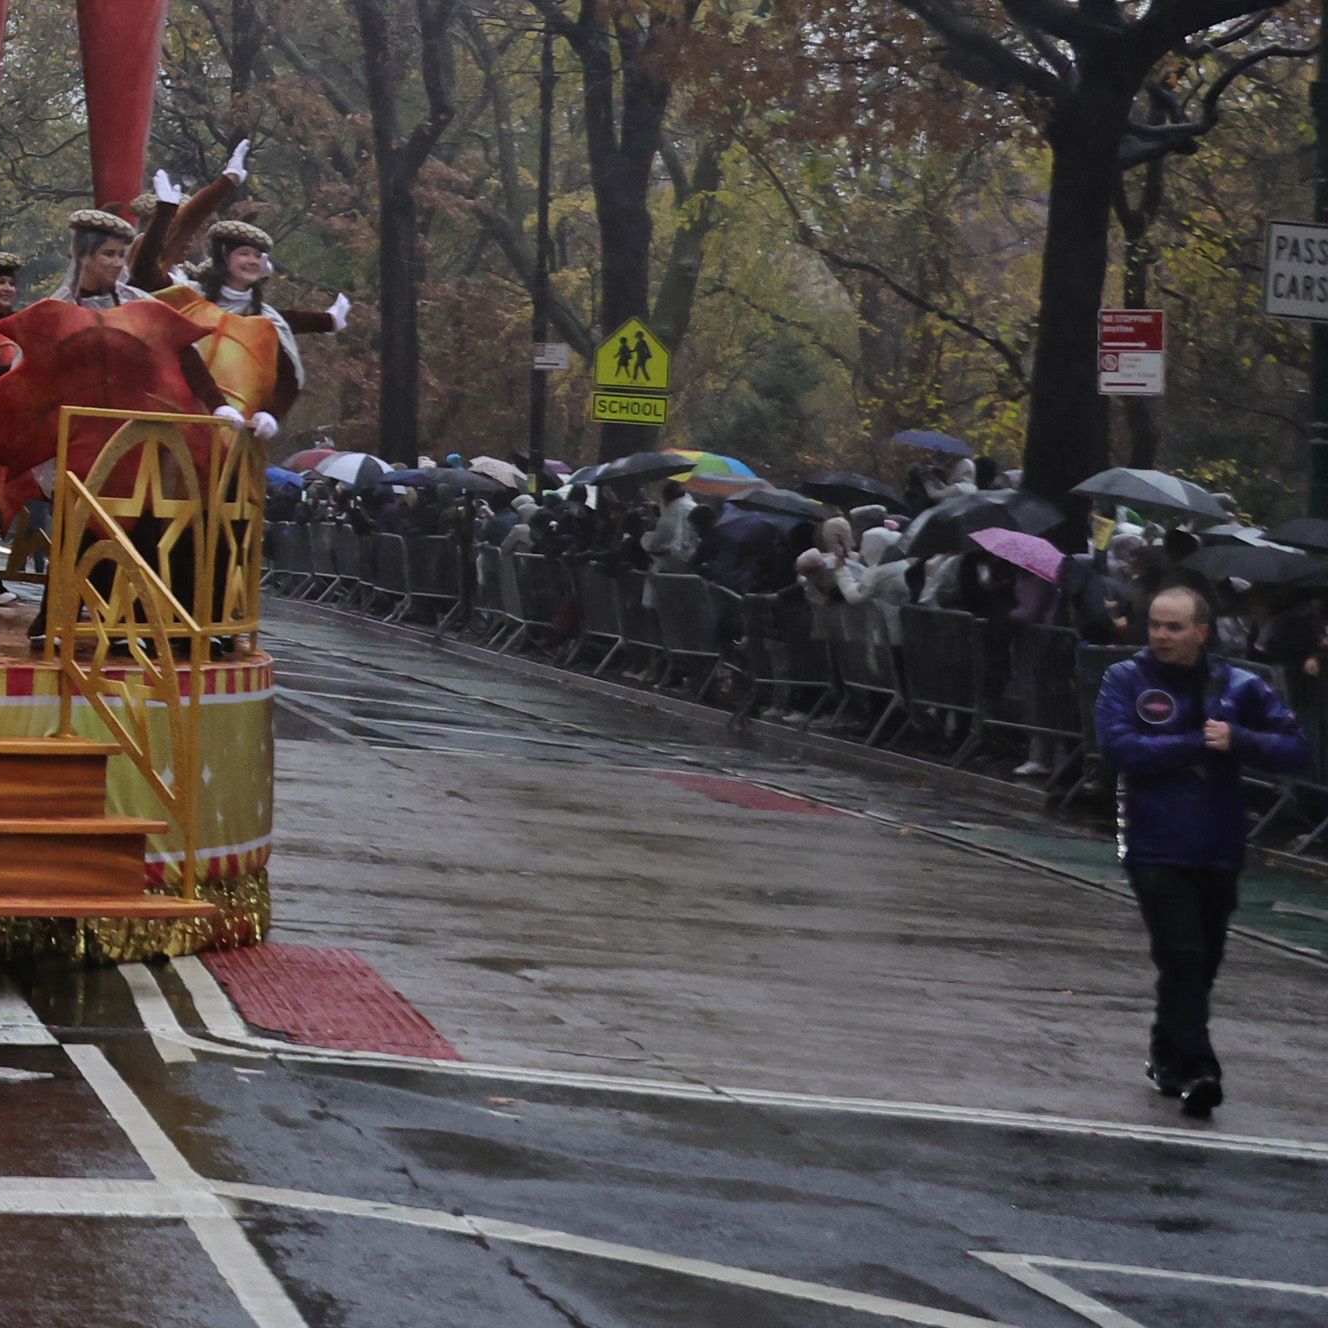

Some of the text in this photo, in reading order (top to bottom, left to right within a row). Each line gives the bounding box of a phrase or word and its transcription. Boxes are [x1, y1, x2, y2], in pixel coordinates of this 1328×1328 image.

[1275, 235, 1328, 265] PASS
[1273, 273, 1328, 303] CARS
[597, 399, 663, 417] SCHOOL
